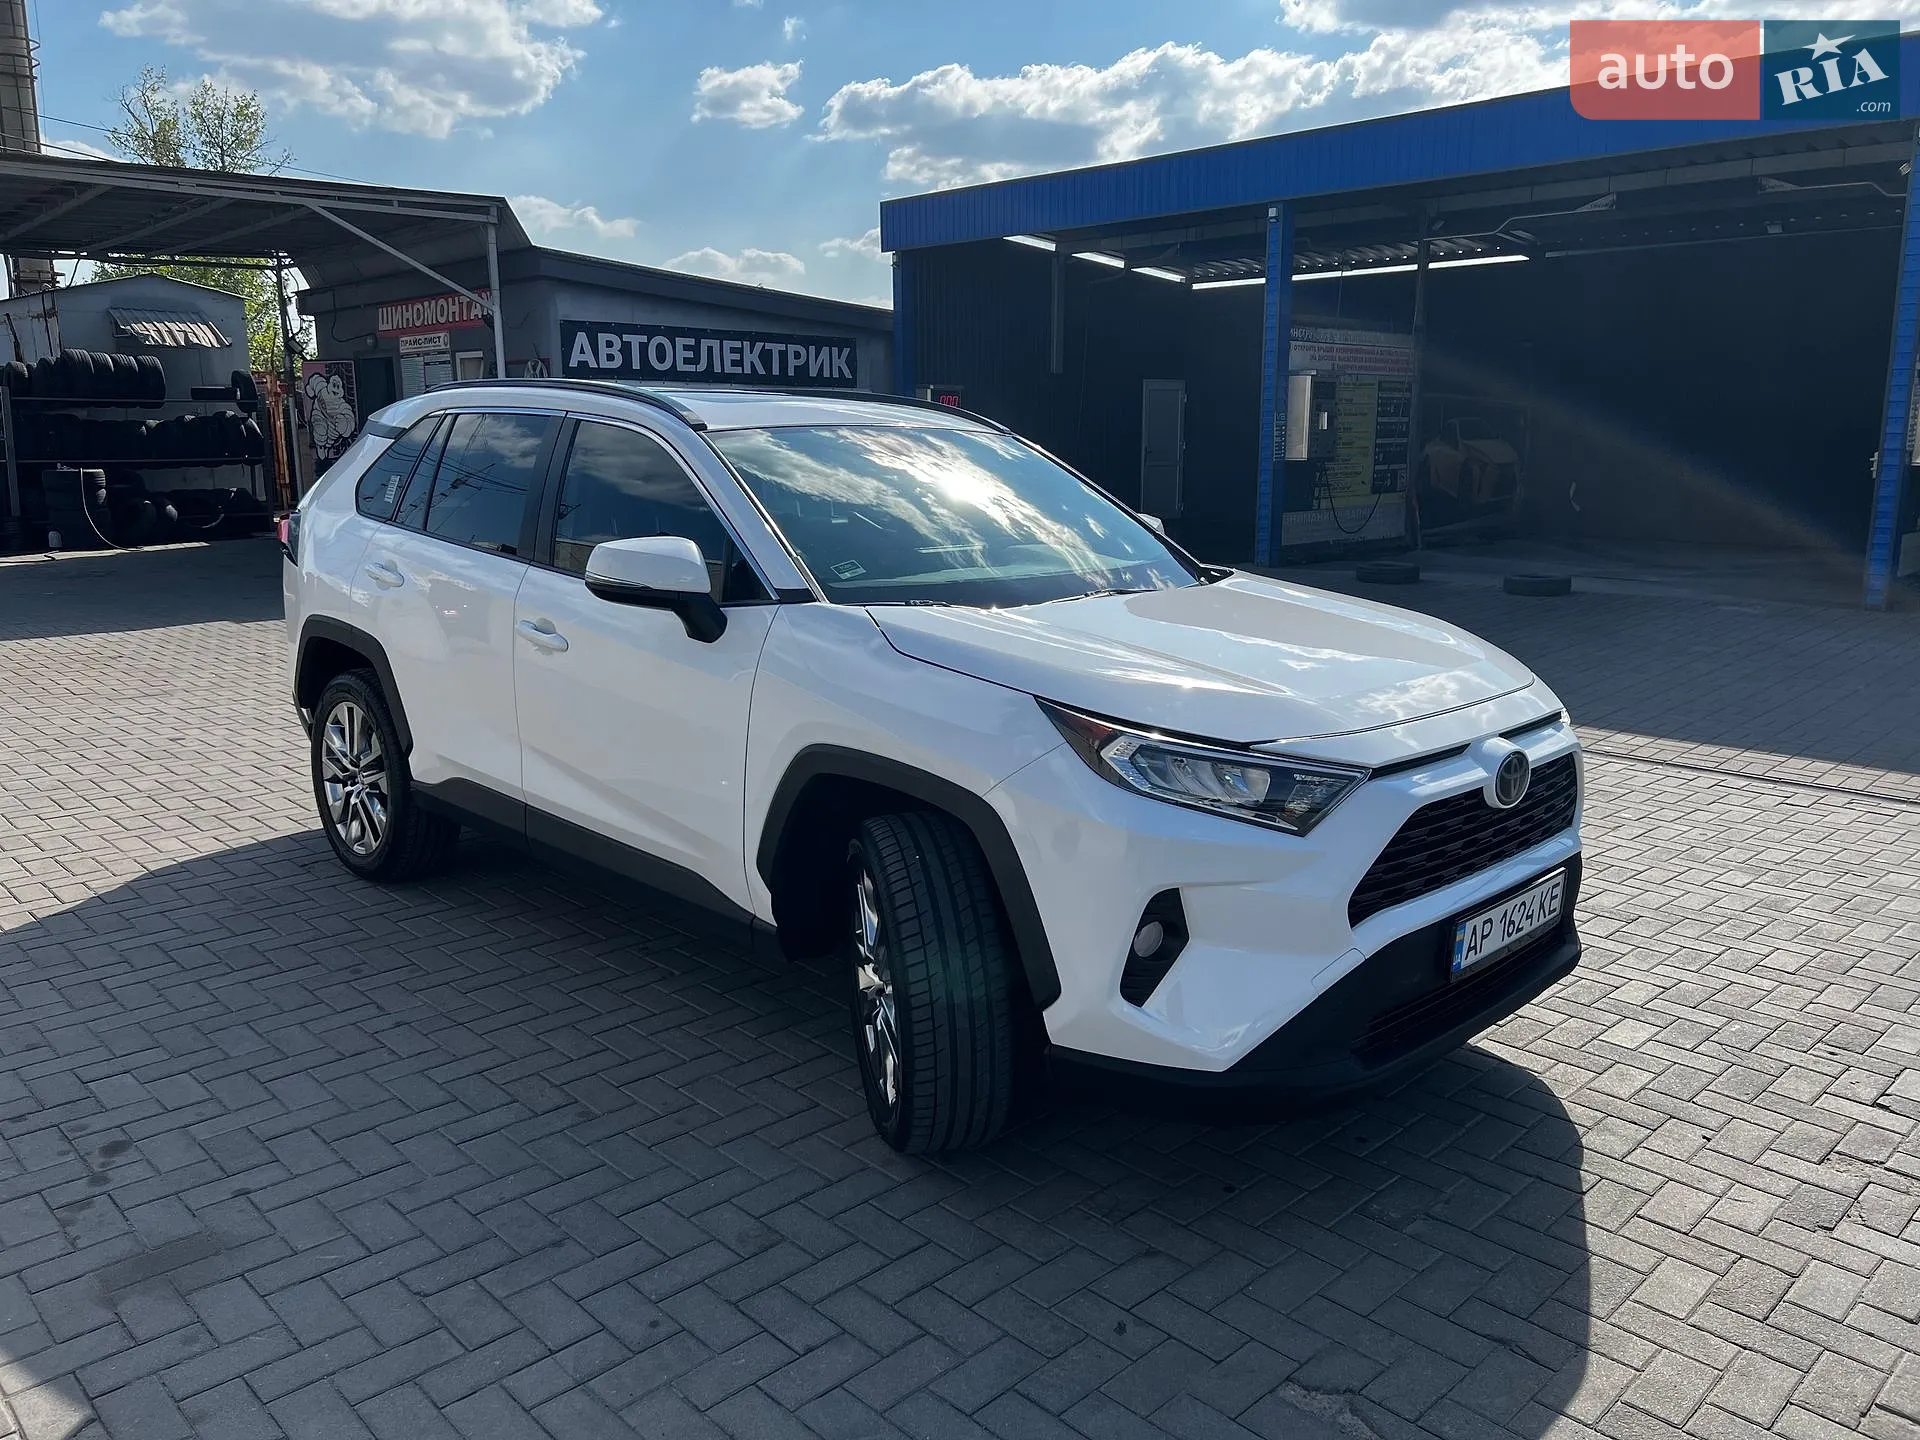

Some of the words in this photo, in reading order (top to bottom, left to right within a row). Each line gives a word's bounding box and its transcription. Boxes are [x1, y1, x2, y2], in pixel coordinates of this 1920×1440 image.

[568, 330, 854, 379] АВТОЕЛЕКТРИК
[1464, 917, 1493, 961] AP
[1499, 894, 1536, 943] 1624
[1536, 881, 1561, 923] KE
